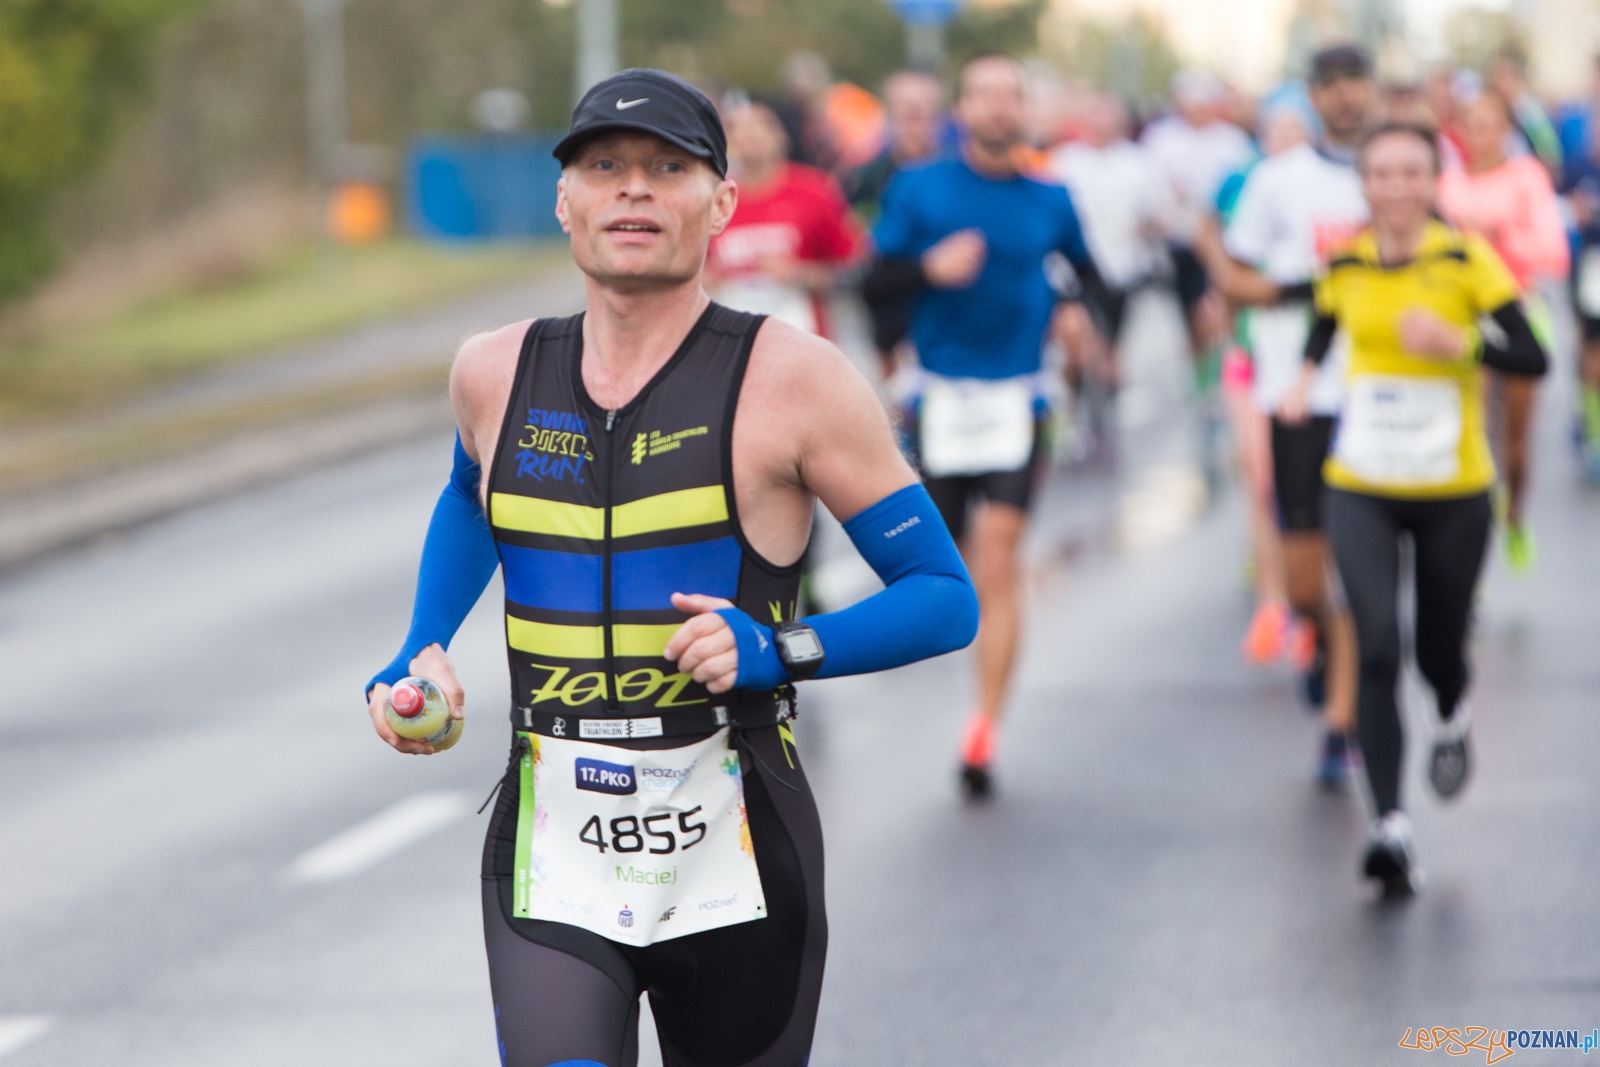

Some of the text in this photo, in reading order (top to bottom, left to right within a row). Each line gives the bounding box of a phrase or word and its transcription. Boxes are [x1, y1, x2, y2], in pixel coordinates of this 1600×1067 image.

[883, 515, 922, 539] techfit
[579, 805, 707, 855] 4855
[615, 866, 678, 885] Maciej
